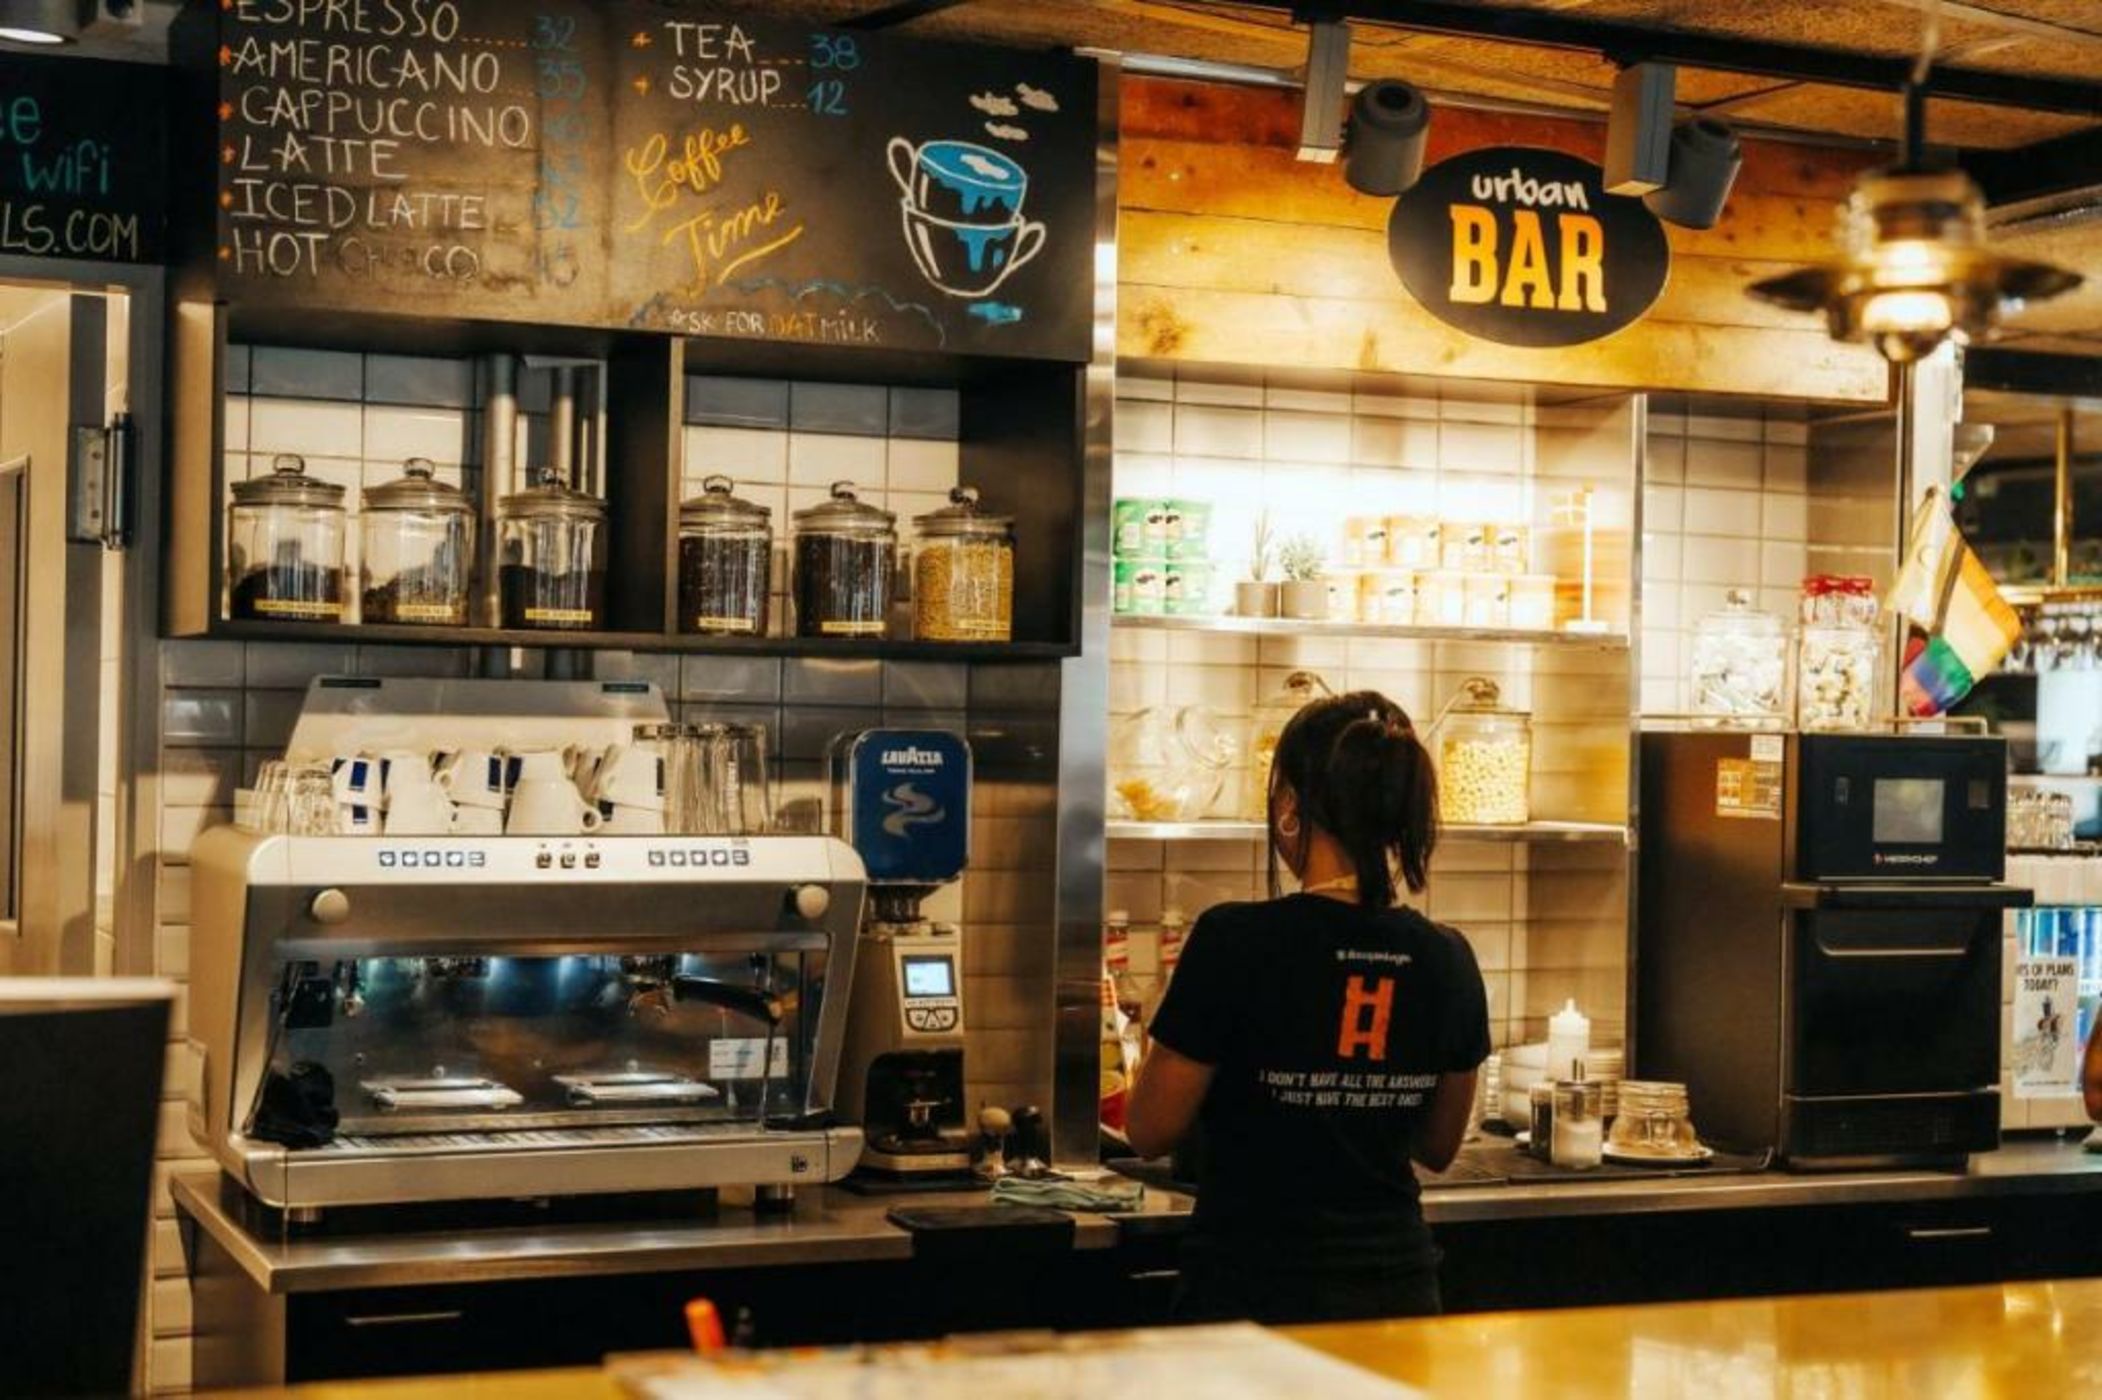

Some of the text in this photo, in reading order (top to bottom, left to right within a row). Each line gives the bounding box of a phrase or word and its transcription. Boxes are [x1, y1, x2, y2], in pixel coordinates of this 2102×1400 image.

[232, 36, 500, 93] AMERICANO
[664, 21, 861, 70] TEA 38
[669, 64, 848, 115] SYRUP 12
[241, 85, 529, 147] CAPPUCCINO
[241, 131, 408, 179] LATTE
[624, 122, 751, 234] Coffee
[230, 178, 357, 229] ICED
[366, 191, 486, 230] LATTE
[1471, 167, 1590, 211] urban
[232, 227, 330, 277] HOT
[1449, 203, 1607, 313] BAR
[725, 311, 767, 334] FOR
[1268, 1070, 1306, 1087] DON'T
